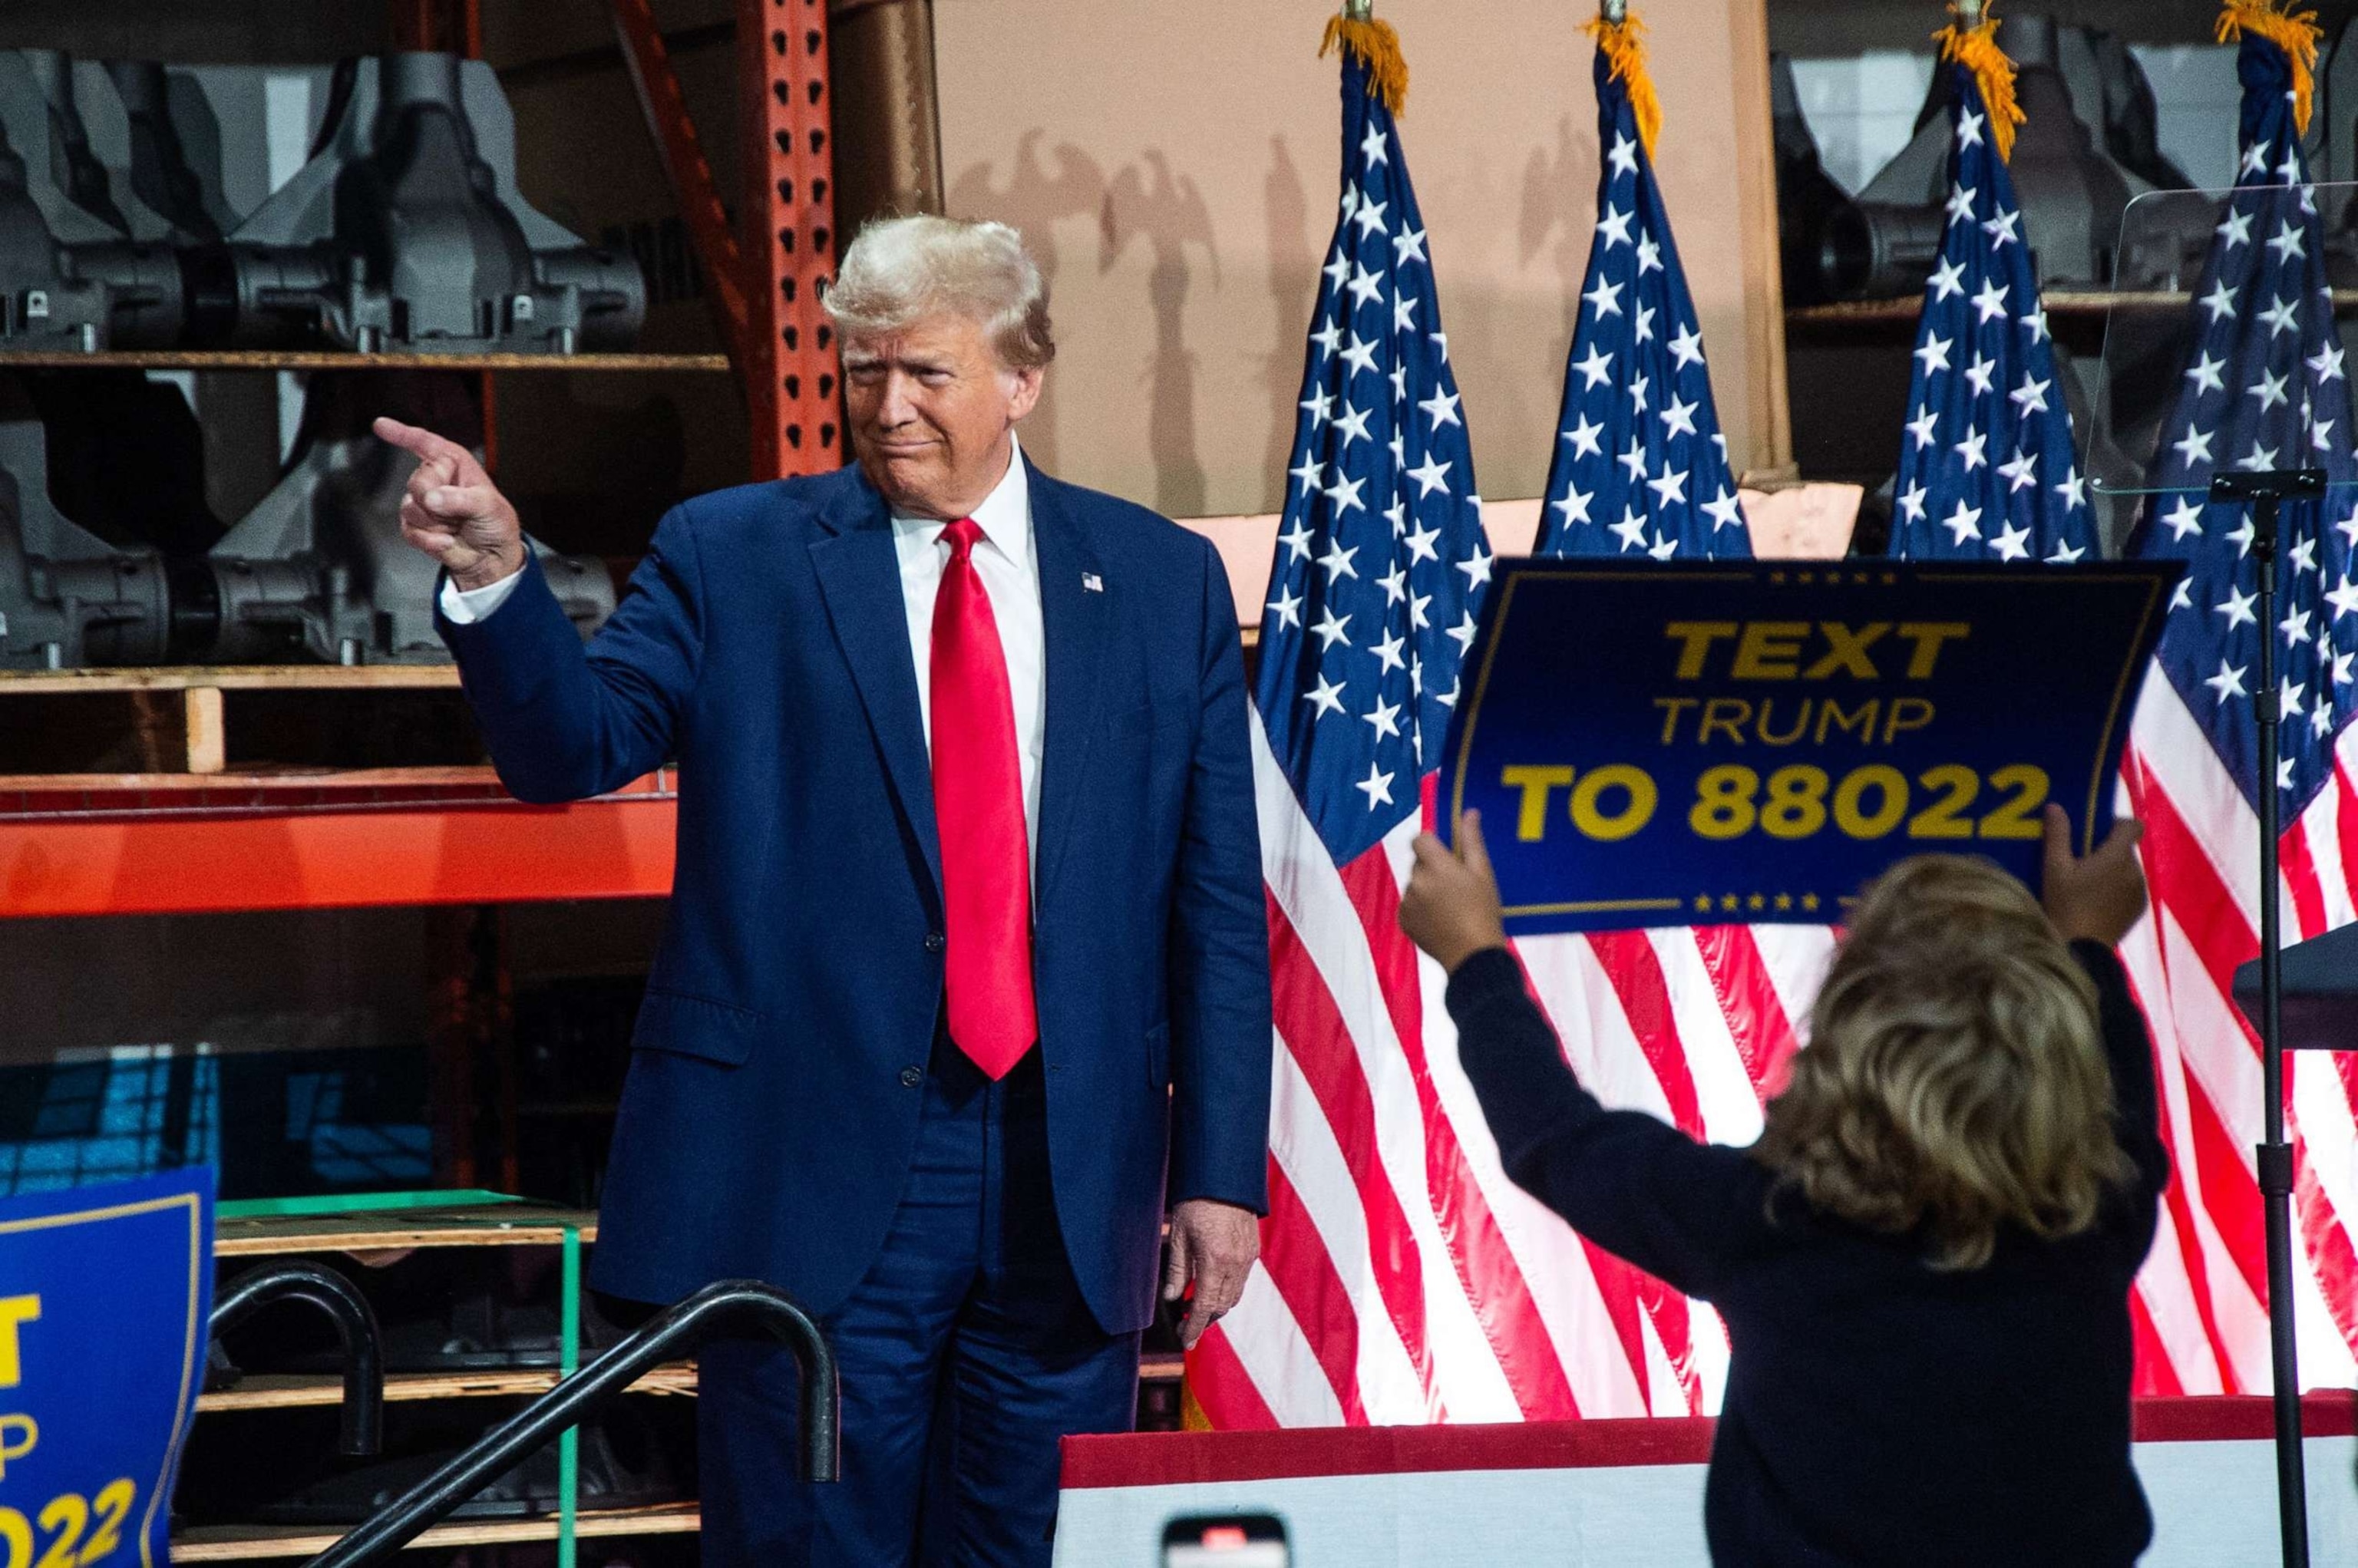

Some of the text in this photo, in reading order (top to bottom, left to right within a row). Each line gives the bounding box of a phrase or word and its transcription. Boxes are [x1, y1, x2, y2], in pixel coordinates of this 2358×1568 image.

[1666, 622, 1970, 680] TEXT
[1653, 698, 1936, 745] TRUMP
[1501, 764, 2050, 842] TO 88022
